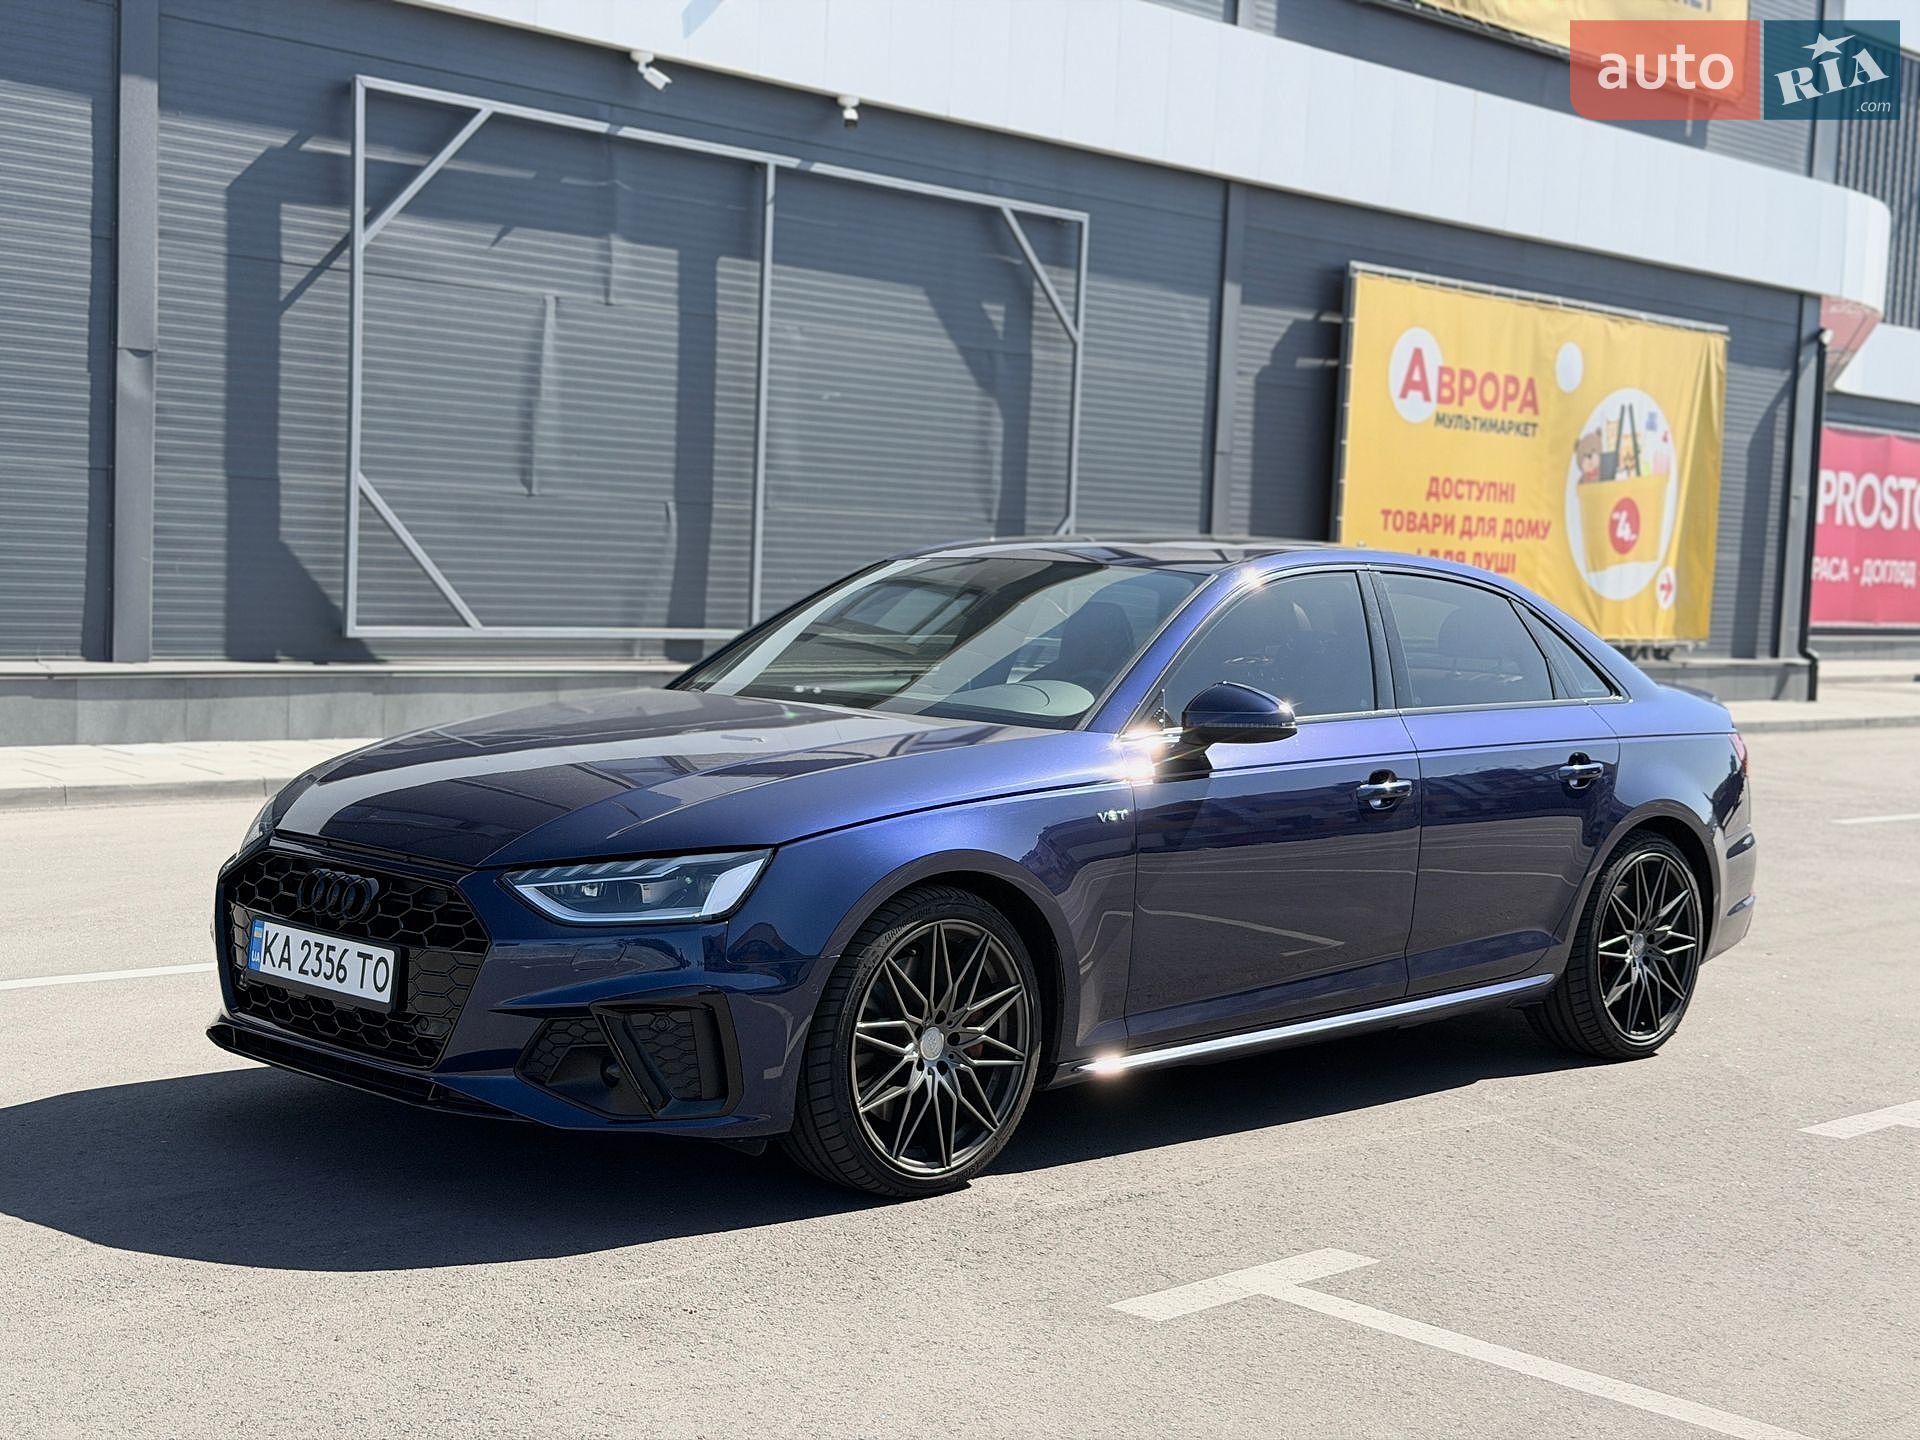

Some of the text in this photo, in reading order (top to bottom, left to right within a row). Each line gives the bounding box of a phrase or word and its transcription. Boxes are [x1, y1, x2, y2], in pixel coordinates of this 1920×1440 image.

[1399, 347, 1540, 416] АВРОРА
[1434, 412, 1539, 438] МУЛЬТИМАРКЕТ
[1425, 476, 1516, 503] ДОСТУПНІ
[1380, 508, 1552, 542] ТОВАРИ ДЛЯ ДОМУ
[262, 930, 390, 993] KA 2356 TO
